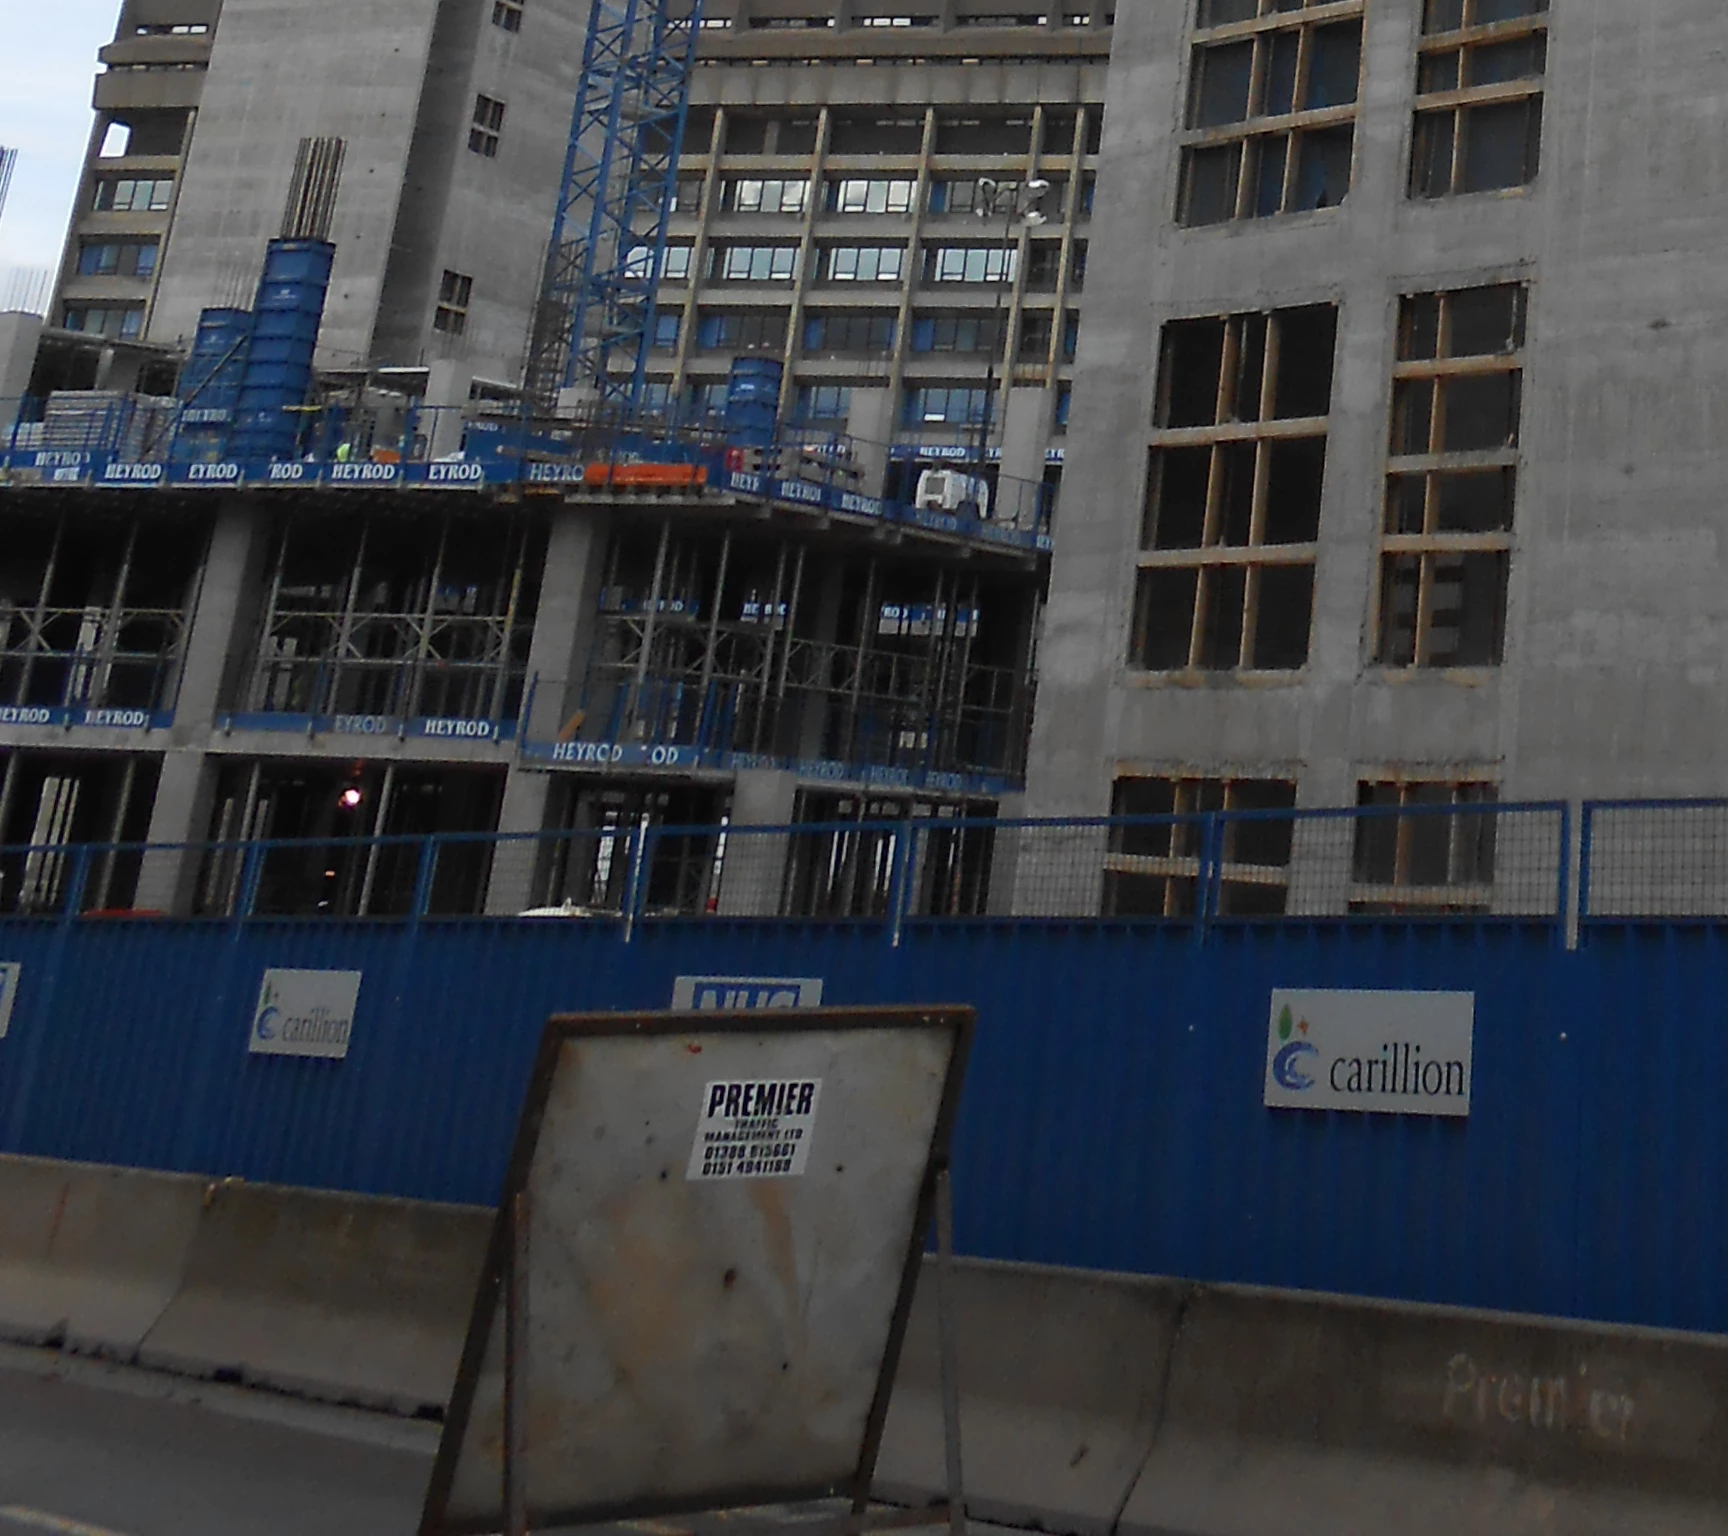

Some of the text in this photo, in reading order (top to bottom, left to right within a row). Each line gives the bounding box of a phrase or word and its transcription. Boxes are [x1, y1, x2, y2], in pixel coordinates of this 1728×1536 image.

[104, 463, 162, 479] HEYROD
[331, 463, 396, 480] HEYROD
[425, 718, 491, 737] HEYROD
[1329, 1042, 1465, 1097] carillion
[708, 1083, 816, 1119] PREMIER
